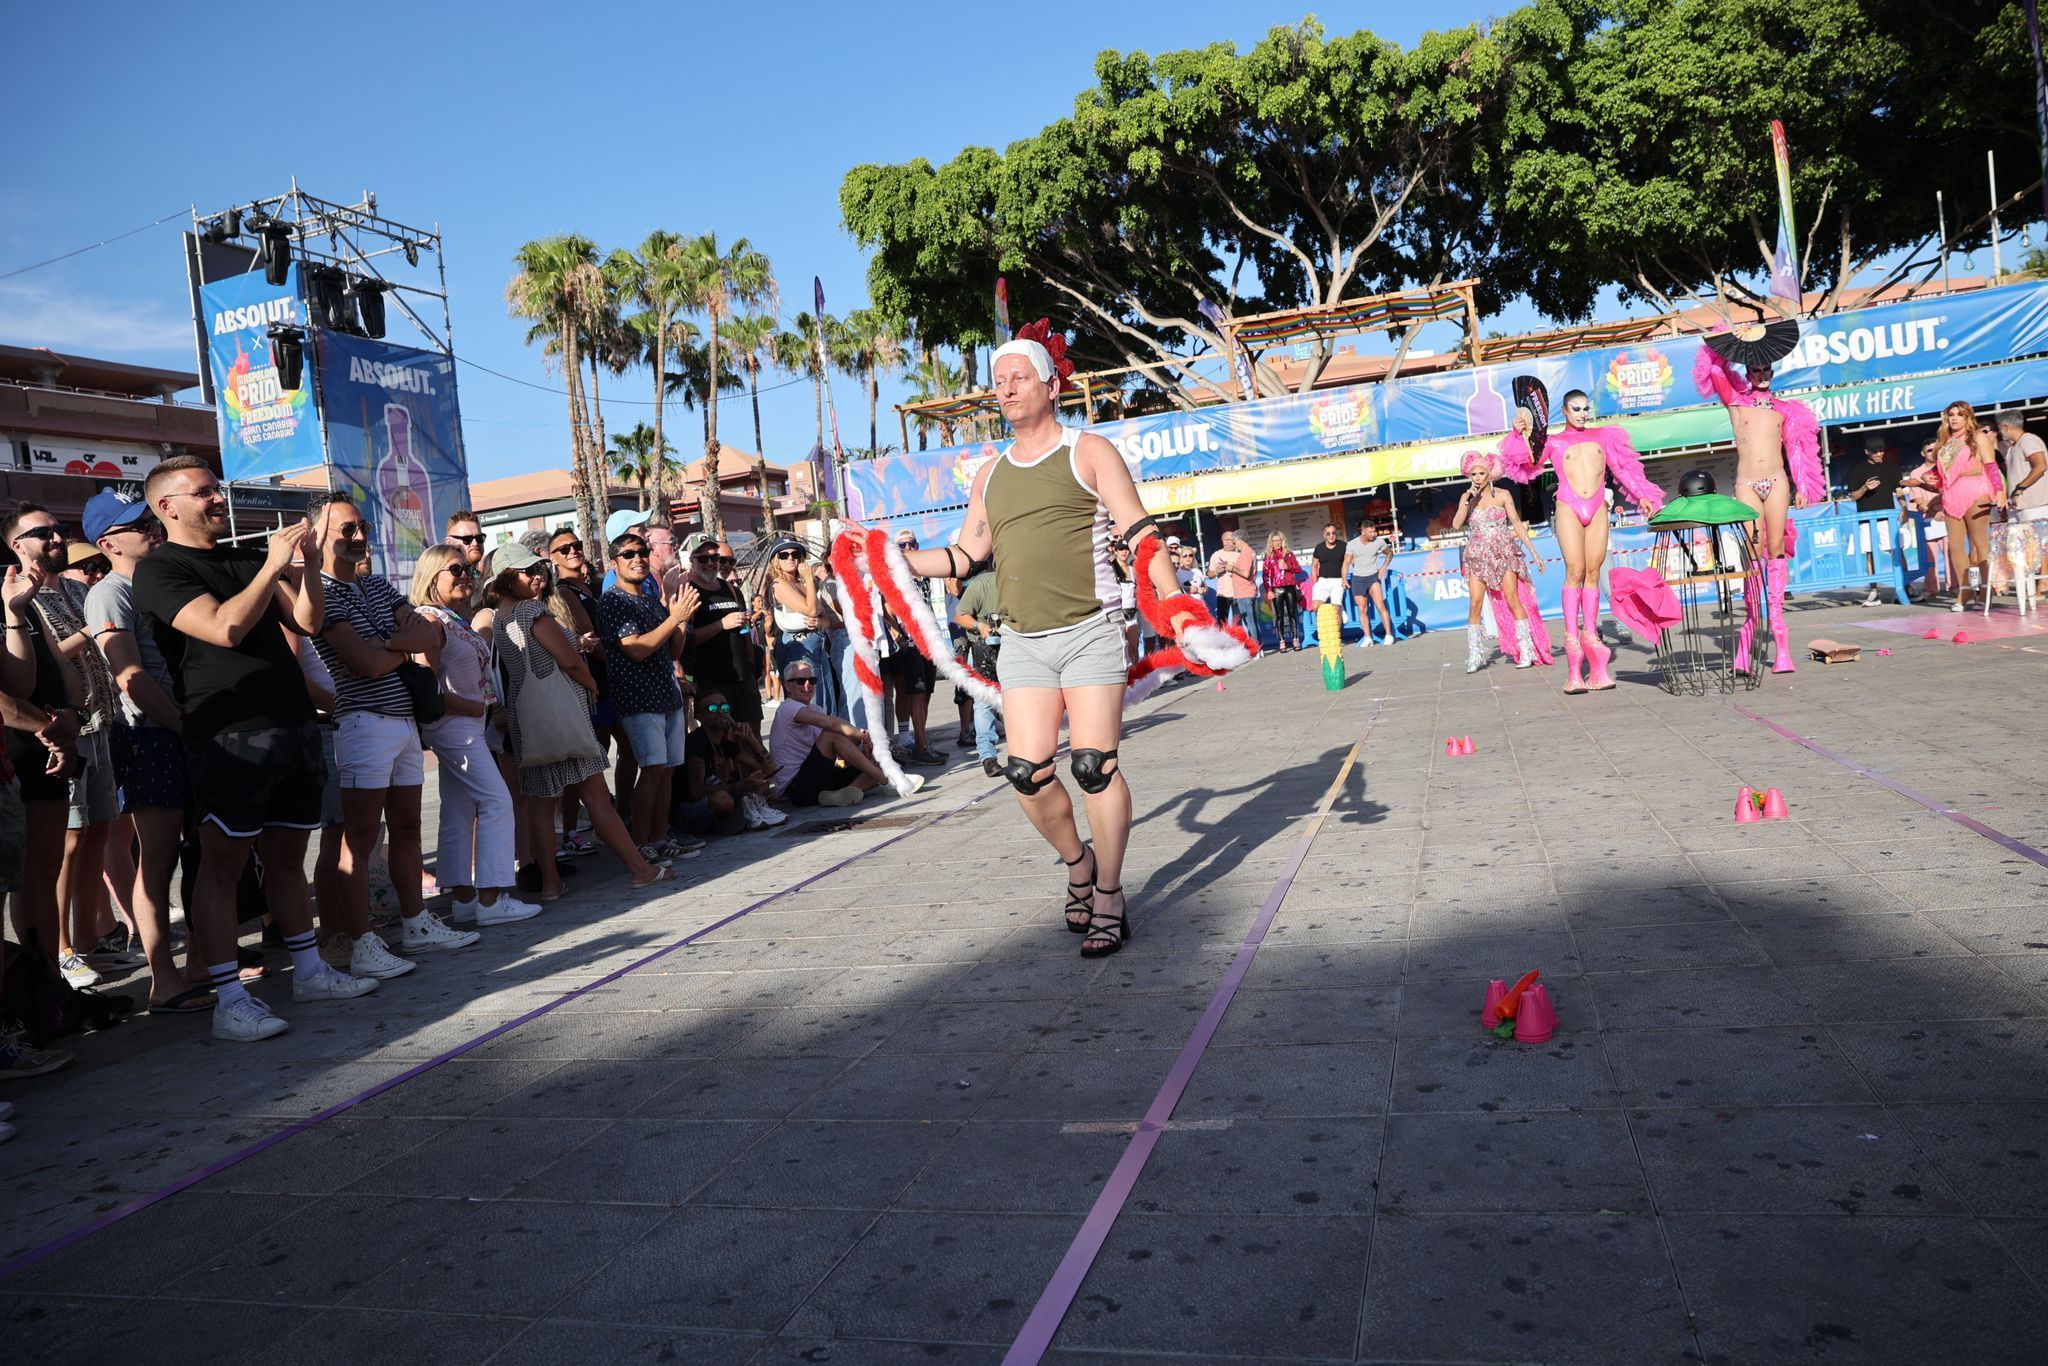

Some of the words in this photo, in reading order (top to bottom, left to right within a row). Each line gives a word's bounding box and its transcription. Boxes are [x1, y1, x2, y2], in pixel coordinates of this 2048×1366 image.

[1780, 316, 1949, 373] ABSOLUT.
[349, 355, 436, 396] ABSOLUT.
[1617, 367, 1661, 386] PRIDE
[1530, 390, 1548, 428] FREEDOM
[1865, 385, 1915, 415] HERE
[240, 403, 294, 427] FREEDOM
[262, 418, 294, 432] CANARIA
[243, 433, 262, 444] ISLAS
[262, 427, 295, 441] CANARIAS
